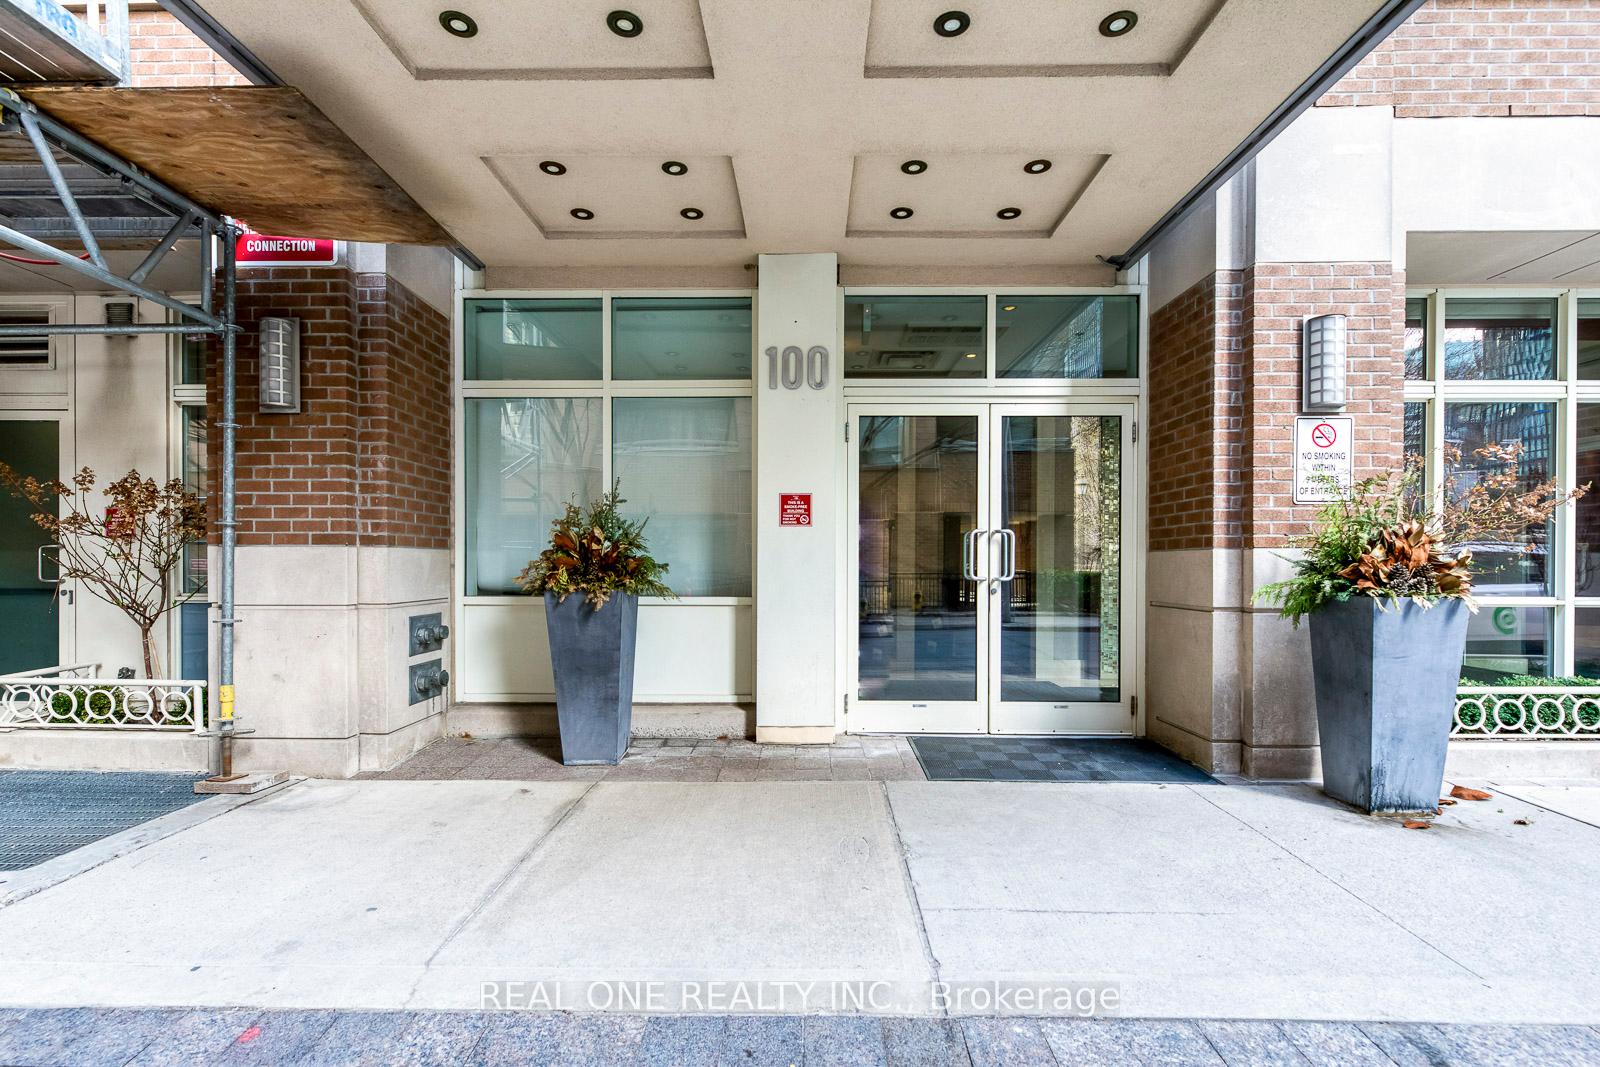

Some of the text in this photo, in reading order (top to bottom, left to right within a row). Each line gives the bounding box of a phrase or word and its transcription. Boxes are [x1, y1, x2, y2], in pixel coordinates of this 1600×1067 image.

[246, 240, 316, 252] CONNECTION
[765, 346, 829, 390] 100
[1302, 452, 1346, 460] NO SMOKING
[1311, 463, 1336, 471] WITHIN
[1299, 487, 1309, 495] OF
